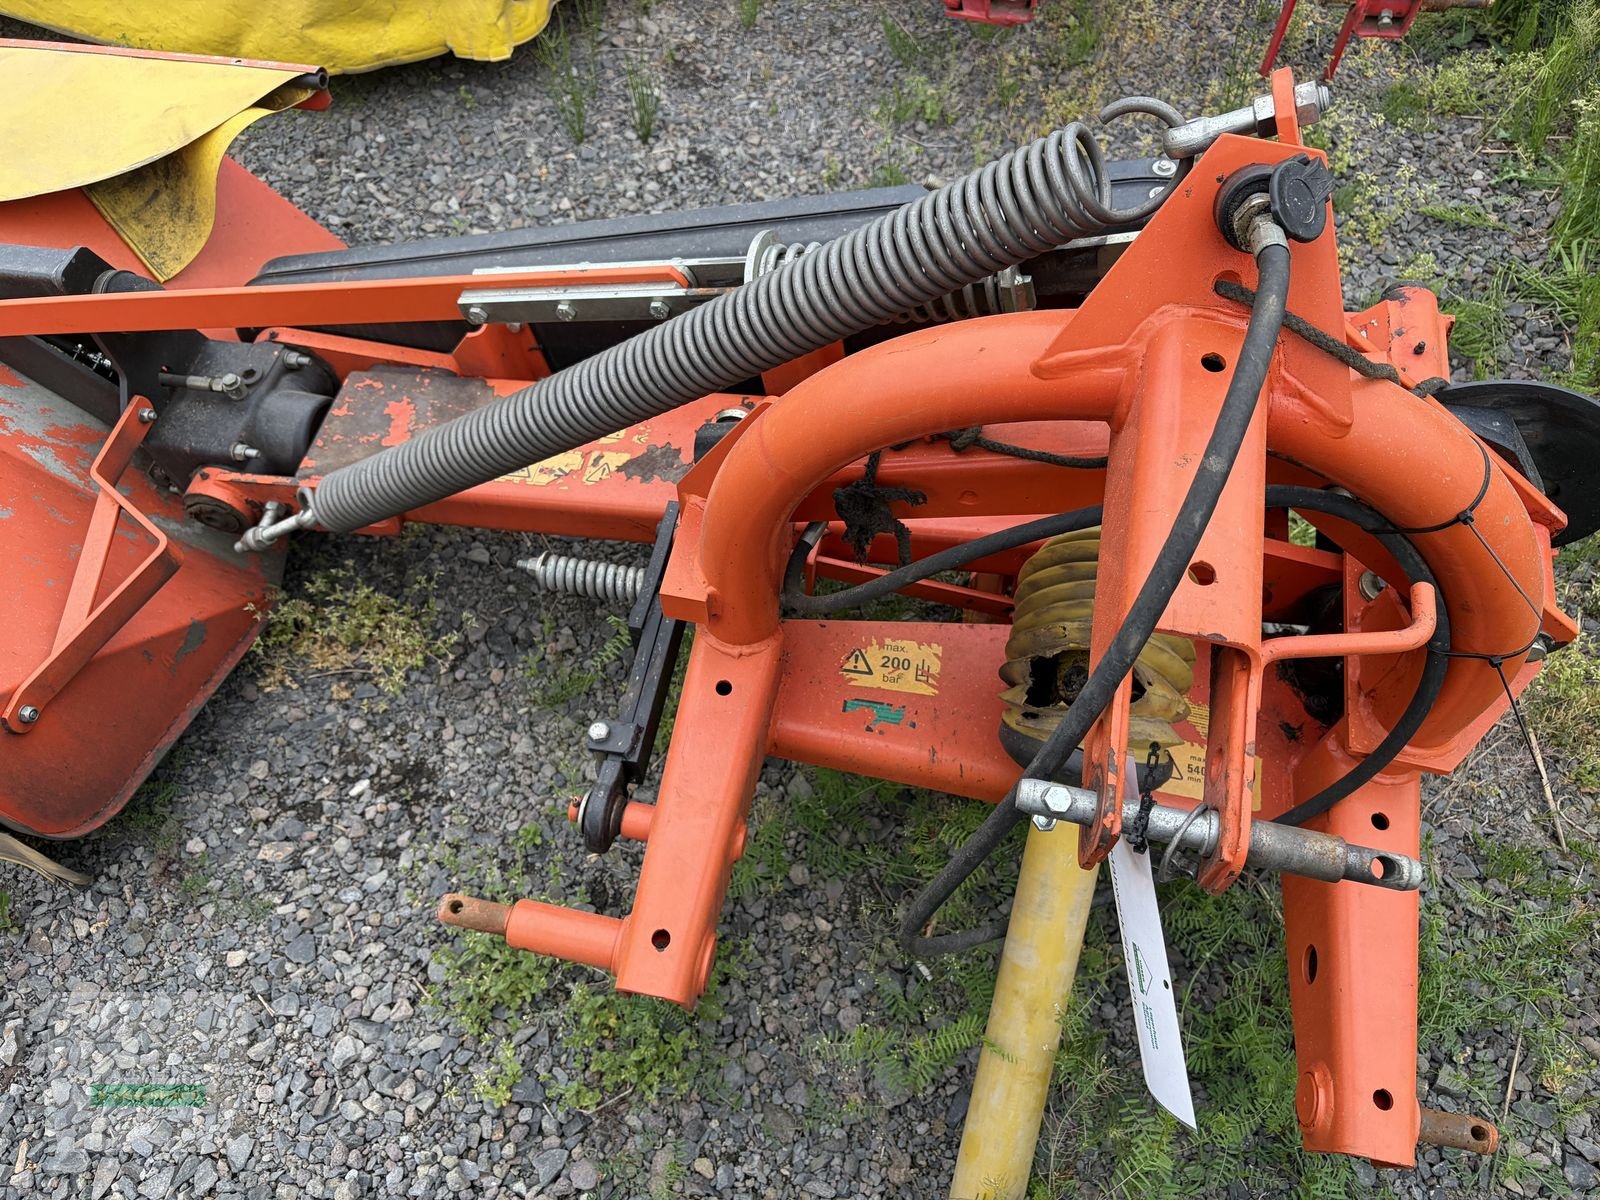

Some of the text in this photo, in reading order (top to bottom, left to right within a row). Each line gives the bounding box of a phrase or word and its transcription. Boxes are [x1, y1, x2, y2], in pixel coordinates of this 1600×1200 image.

[884, 643, 908, 653] max.
[880, 655, 911, 671] 200
[882, 673, 900, 684] bar
